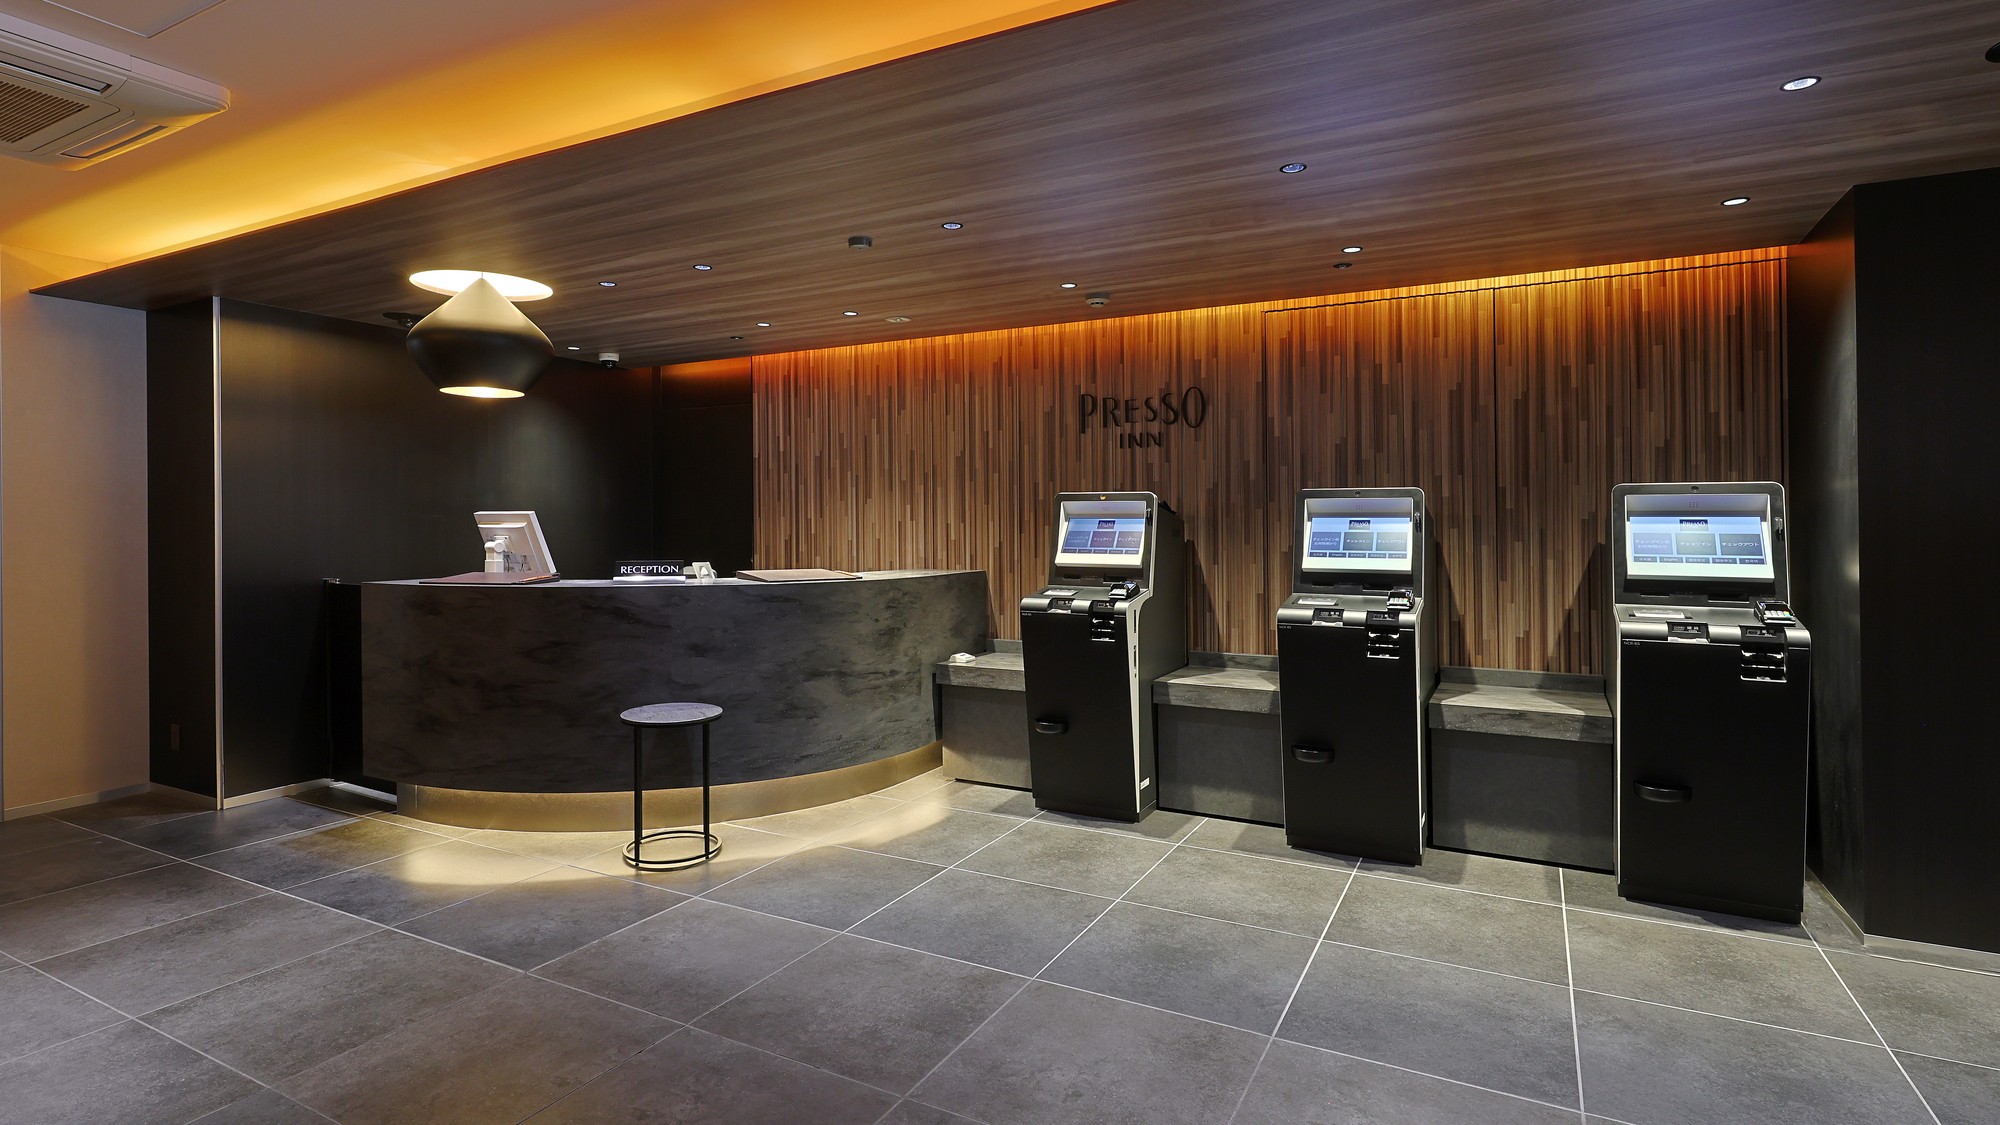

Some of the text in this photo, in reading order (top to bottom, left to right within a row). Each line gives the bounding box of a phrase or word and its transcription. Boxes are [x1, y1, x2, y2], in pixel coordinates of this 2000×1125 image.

[1080, 386, 1206, 434] PRESSO
[1119, 432, 1163, 449] INN
[620, 565, 679, 574] RECEPTION
